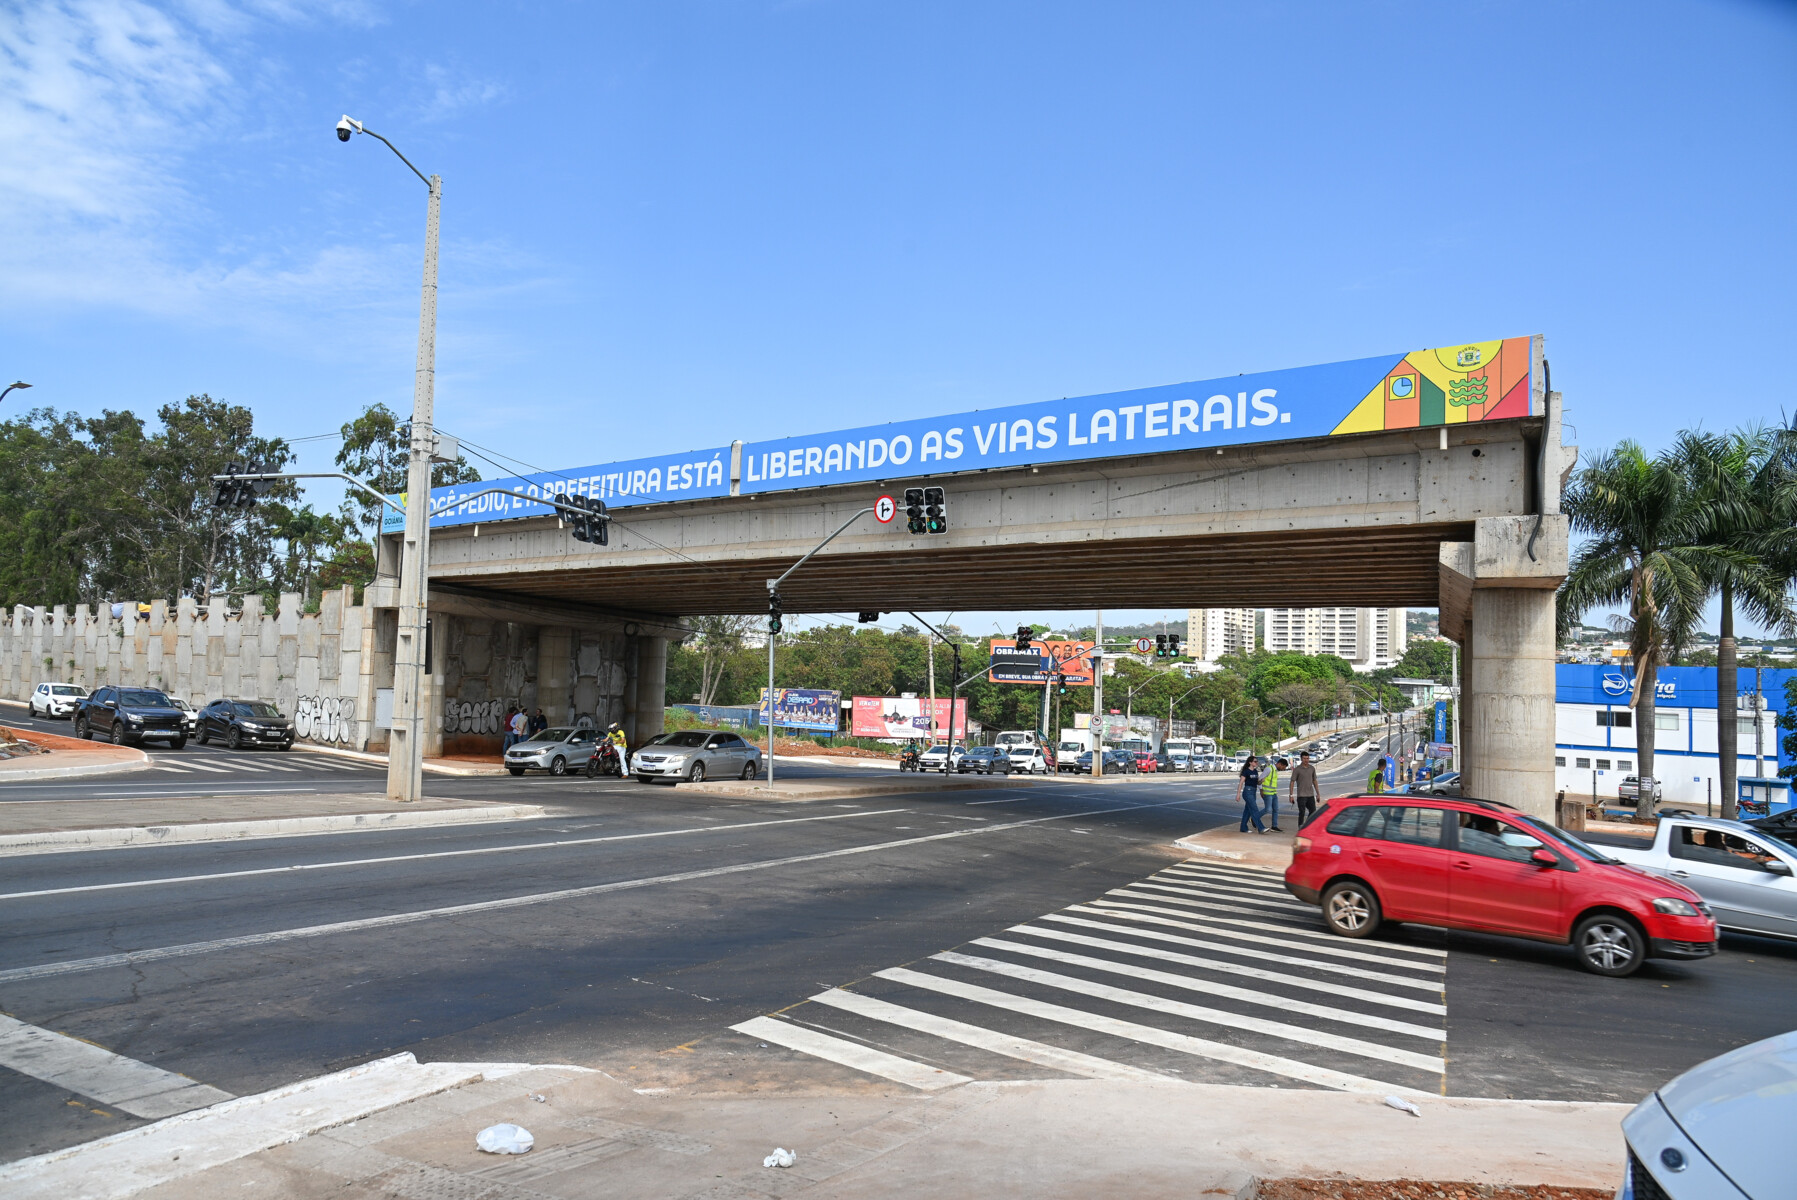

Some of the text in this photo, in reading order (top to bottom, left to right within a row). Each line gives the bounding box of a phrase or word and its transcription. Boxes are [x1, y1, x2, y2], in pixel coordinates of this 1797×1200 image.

[747, 389, 1291, 482] LIBERANDO AS VIAS LATERAIS.
[430, 453, 723, 518] OCÊ PEDIU, E A PREFEITURA ESTÁ
